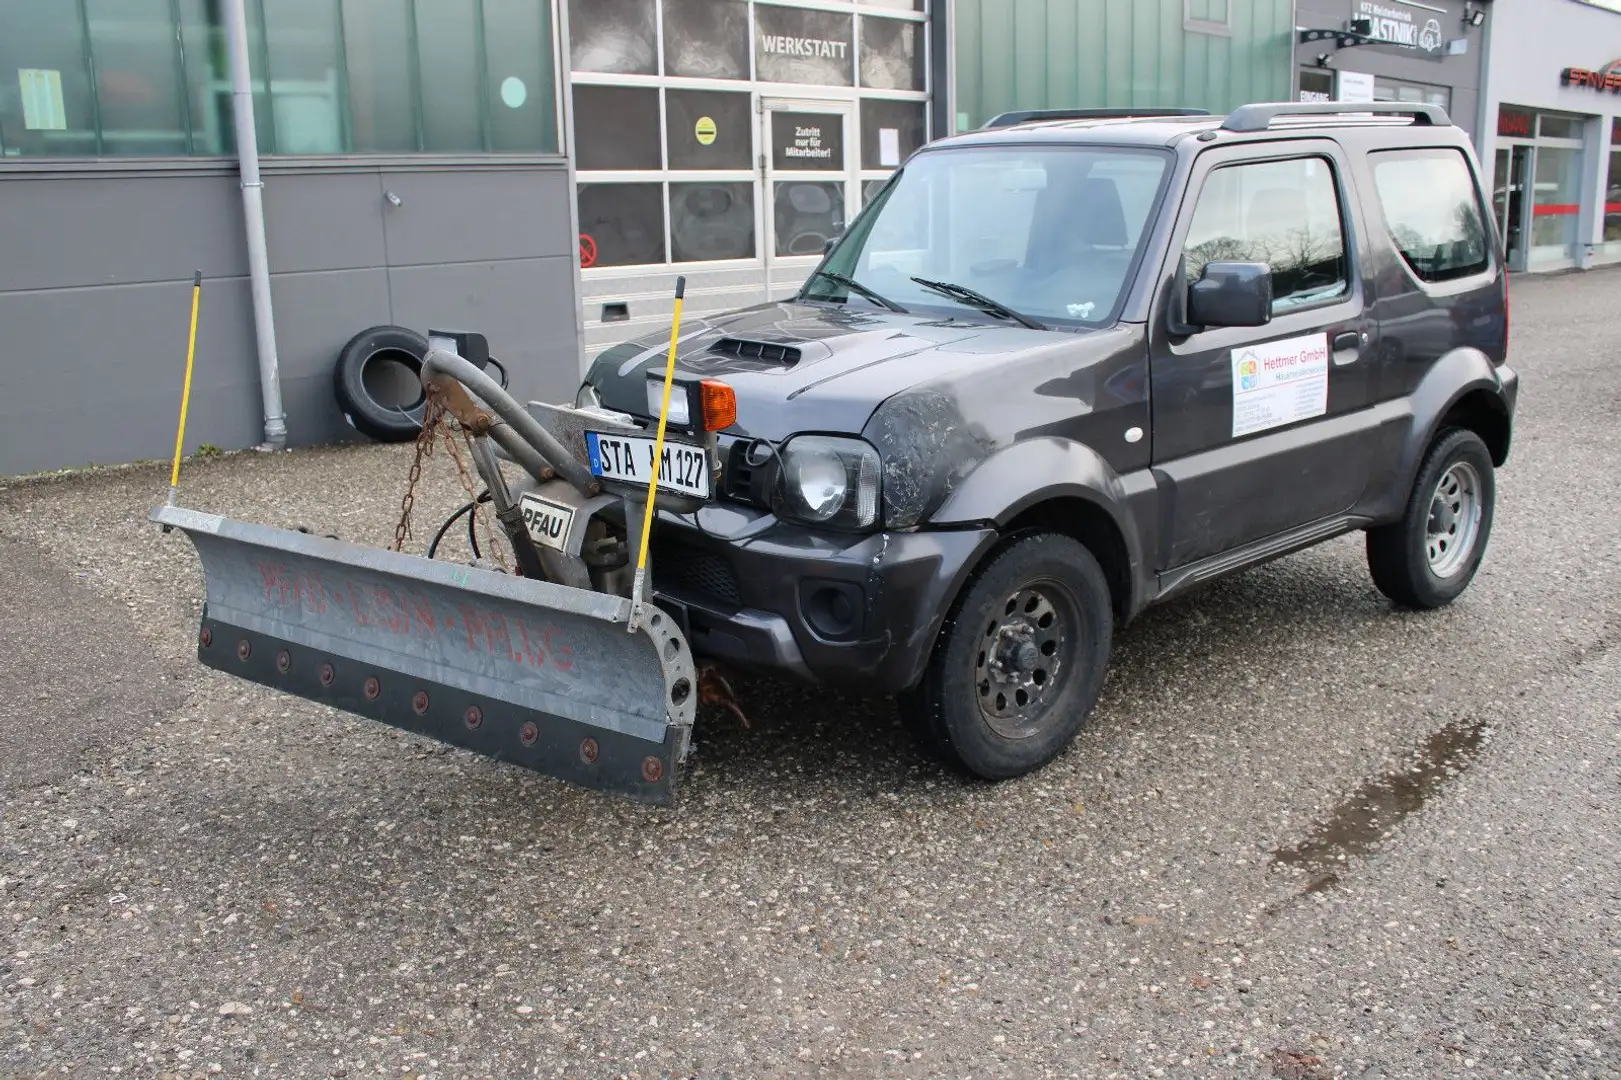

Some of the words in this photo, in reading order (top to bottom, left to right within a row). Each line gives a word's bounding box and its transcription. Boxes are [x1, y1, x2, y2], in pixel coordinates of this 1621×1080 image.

[1354, 12, 1414, 44] ASTNIK
[762, 34, 847, 58] WERKSTATT
[795, 126, 821, 138] Zutritt
[795, 138, 808, 147] nur
[809, 137, 822, 147] für
[785, 146, 831, 158] Mitarbeiter!
[1263, 355, 1298, 371] Hettmer
[1299, 347, 1326, 363] GmbH
[600, 439, 636, 476] STA
[676, 449, 704, 489] 127
[523, 507, 564, 539] PFAU
